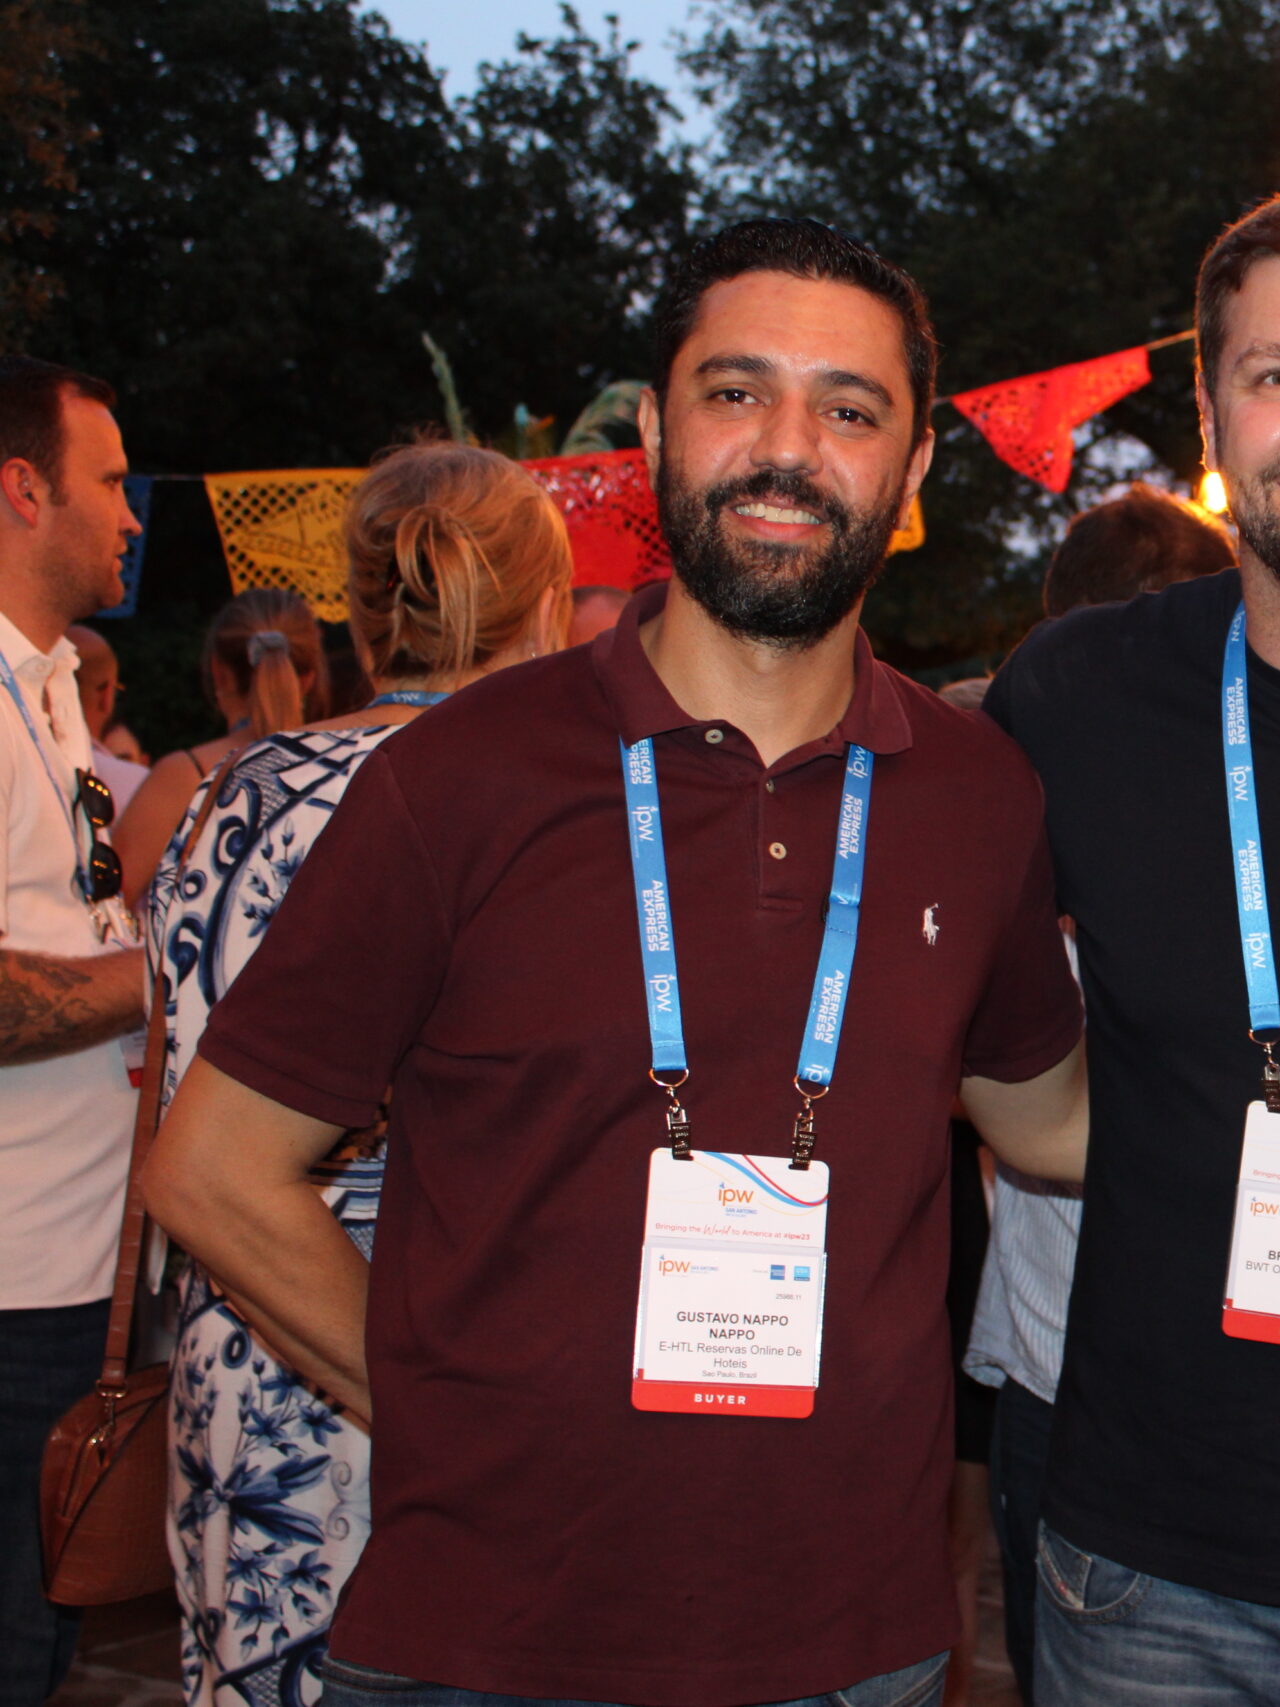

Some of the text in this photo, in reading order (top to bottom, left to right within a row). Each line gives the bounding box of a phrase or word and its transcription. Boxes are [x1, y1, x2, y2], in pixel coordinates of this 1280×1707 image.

[1226, 687, 1237, 746] EXPRESS
[1234, 677, 1247, 744] AMERICAN
[631, 744, 643, 785] PRESS
[639, 739, 653, 784] ERICAN
[847, 747, 868, 779] ipw
[1229, 765, 1251, 801] ipw
[632, 805, 658, 842] ipw
[839, 794, 854, 860] AMERICAN
[850, 797, 863, 854] EXPRESS
[1238, 849, 1253, 912] EXPRESS
[1246, 839, 1263, 911] AMERICAN
[642, 889, 660, 952] EXPRESS
[652, 879, 671, 952] AMERICAN
[1245, 932, 1269, 969] ipw
[650, 974, 677, 1013] ipw
[814, 976, 834, 1042] EXPRESS
[825, 969, 845, 1044] AMERICAN
[805, 1064, 830, 1083] ip
[718, 1183, 754, 1206] ipw
[1250, 1197, 1279, 1216] ipw
[655, 1222, 811, 1241] Bringing the World to America at #ipw23
[658, 1255, 692, 1277] ipw
[1245, 1260, 1269, 1273] BWT
[677, 1311, 789, 1327] GUSTAVO NAPPO
[709, 1328, 756, 1341] NAPPO
[659, 1341, 802, 1357] E-HTL Reservas Online De
[713, 1358, 748, 1369] Hoteis
[739, 1371, 758, 1379] Brazil
[694, 1393, 747, 1405] BUYER
